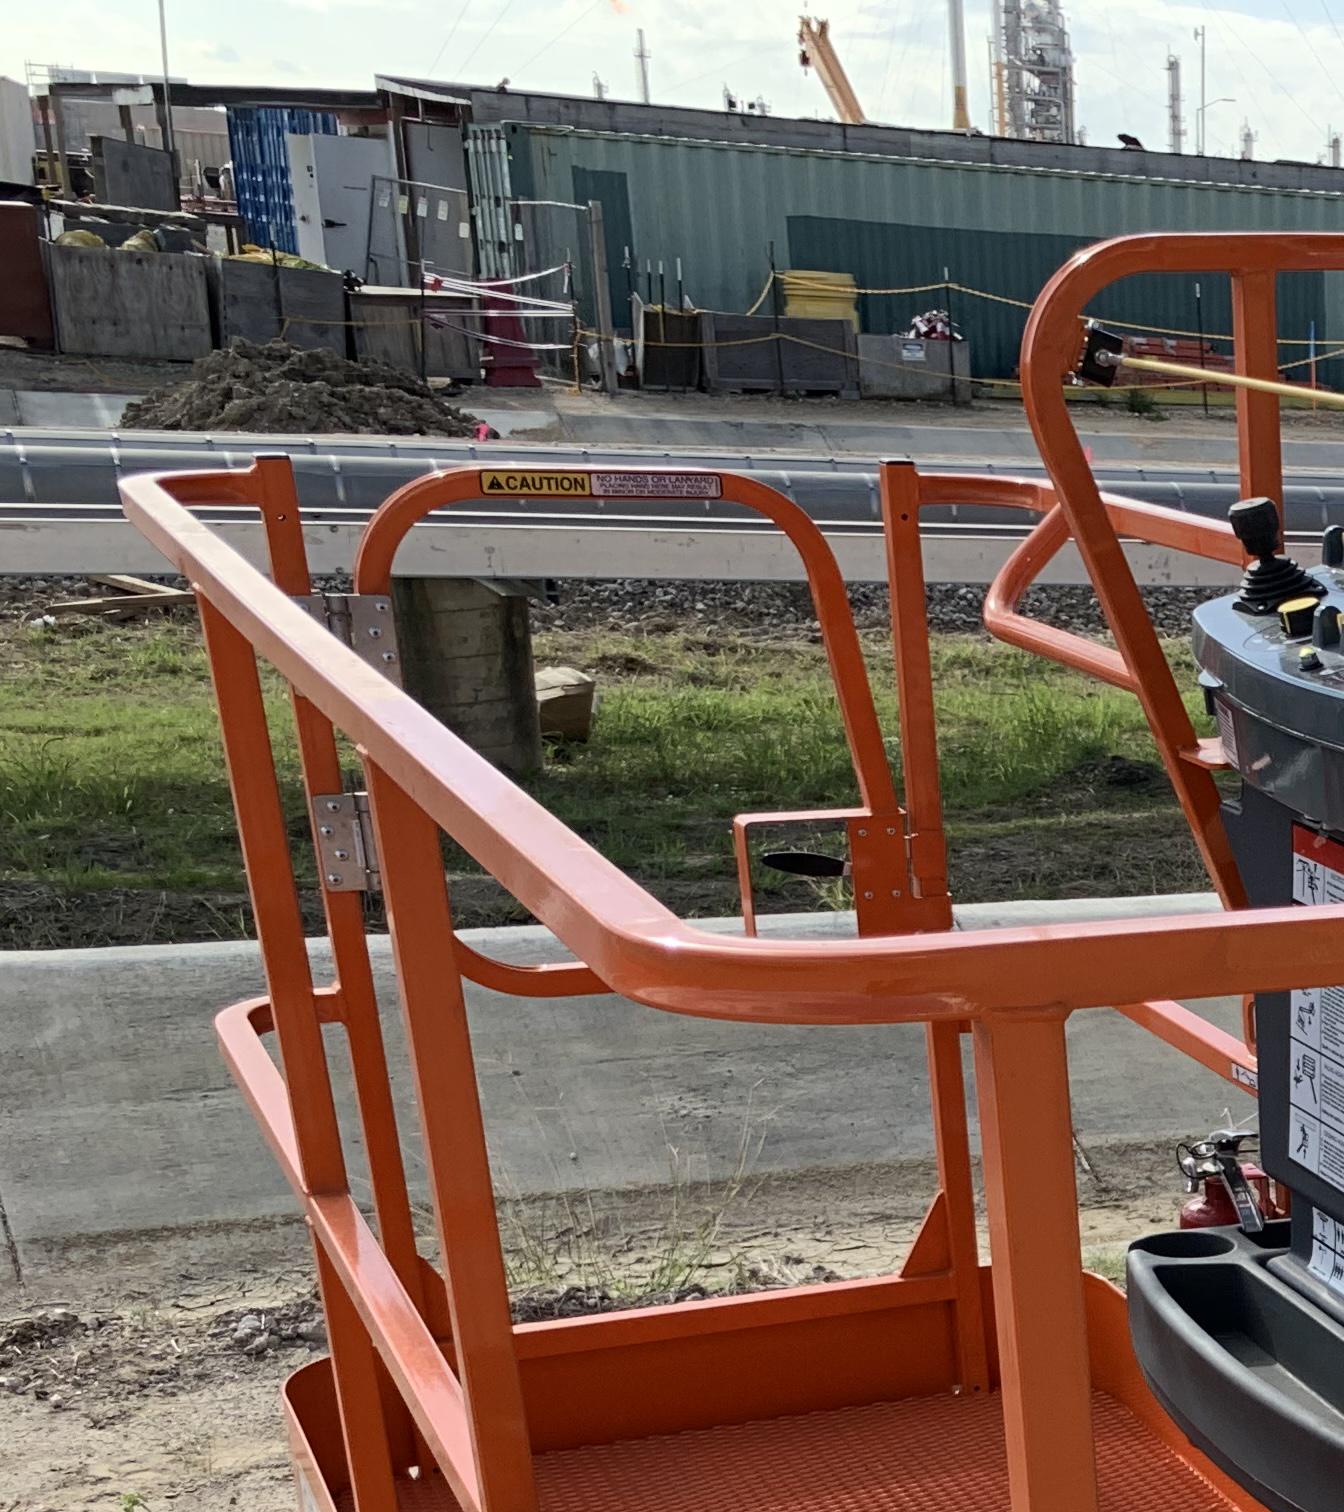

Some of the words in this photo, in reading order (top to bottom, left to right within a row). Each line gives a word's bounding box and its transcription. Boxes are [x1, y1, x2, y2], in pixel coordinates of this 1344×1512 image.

[505, 476, 586, 492] CAUTION
[597, 475, 612, 483] NO
[615, 475, 649, 484] HANDS
[651, 475, 667, 484] OR
[668, 476, 714, 484] LANYARD
